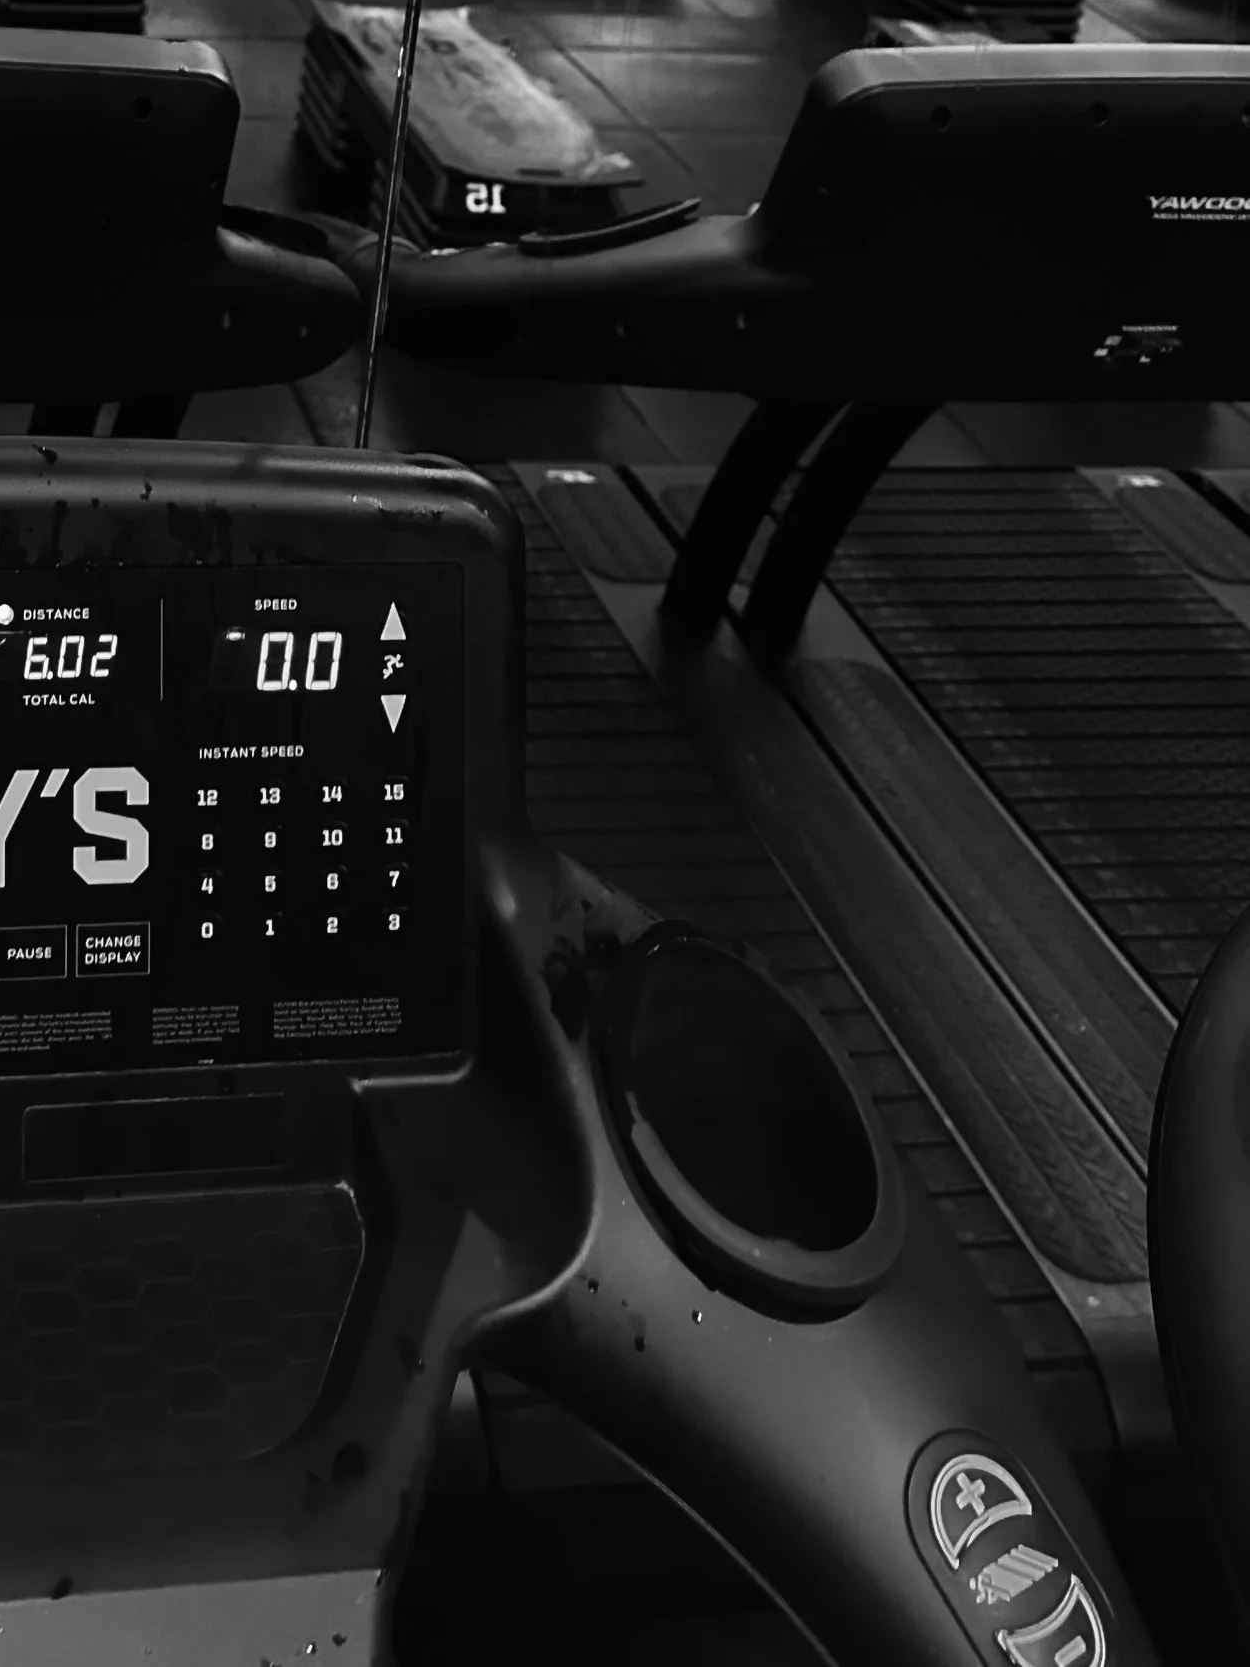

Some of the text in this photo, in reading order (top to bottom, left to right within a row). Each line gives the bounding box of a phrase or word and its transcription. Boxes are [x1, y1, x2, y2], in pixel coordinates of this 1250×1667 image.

[255, 599, 297, 610] SPEED
[24, 608, 89, 620] DISTANCE
[24, 635, 117, 679] 6.02
[257, 632, 342, 691] 0.0
[23, 694, 95, 705] TOTAL CAL
[200, 746, 303, 759] INSTANT SPEED
[198, 790, 217, 806] 12
[261, 788, 280, 804] 13
[323, 786, 342, 802] 14
[385, 784, 404, 800] 15
[202, 834, 213, 850] 8
[265, 832, 276, 848] 9
[323, 830, 342, 846] 10
[386, 828, 403, 844] 11
[202, 878, 213, 894] 4
[265, 876, 276, 892] 5
[327, 873, 338, 889] 6
[389, 871, 399, 887] 7
[202, 922, 213, 938] 0
[266, 920, 274, 935] 1
[327, 917, 338, 933] 2
[389, 914, 400, 930] 3
[86, 936, 140, 948] CHANGE
[8, 947, 51, 959] PAUSE
[85, 951, 140, 964] DISPLAY
